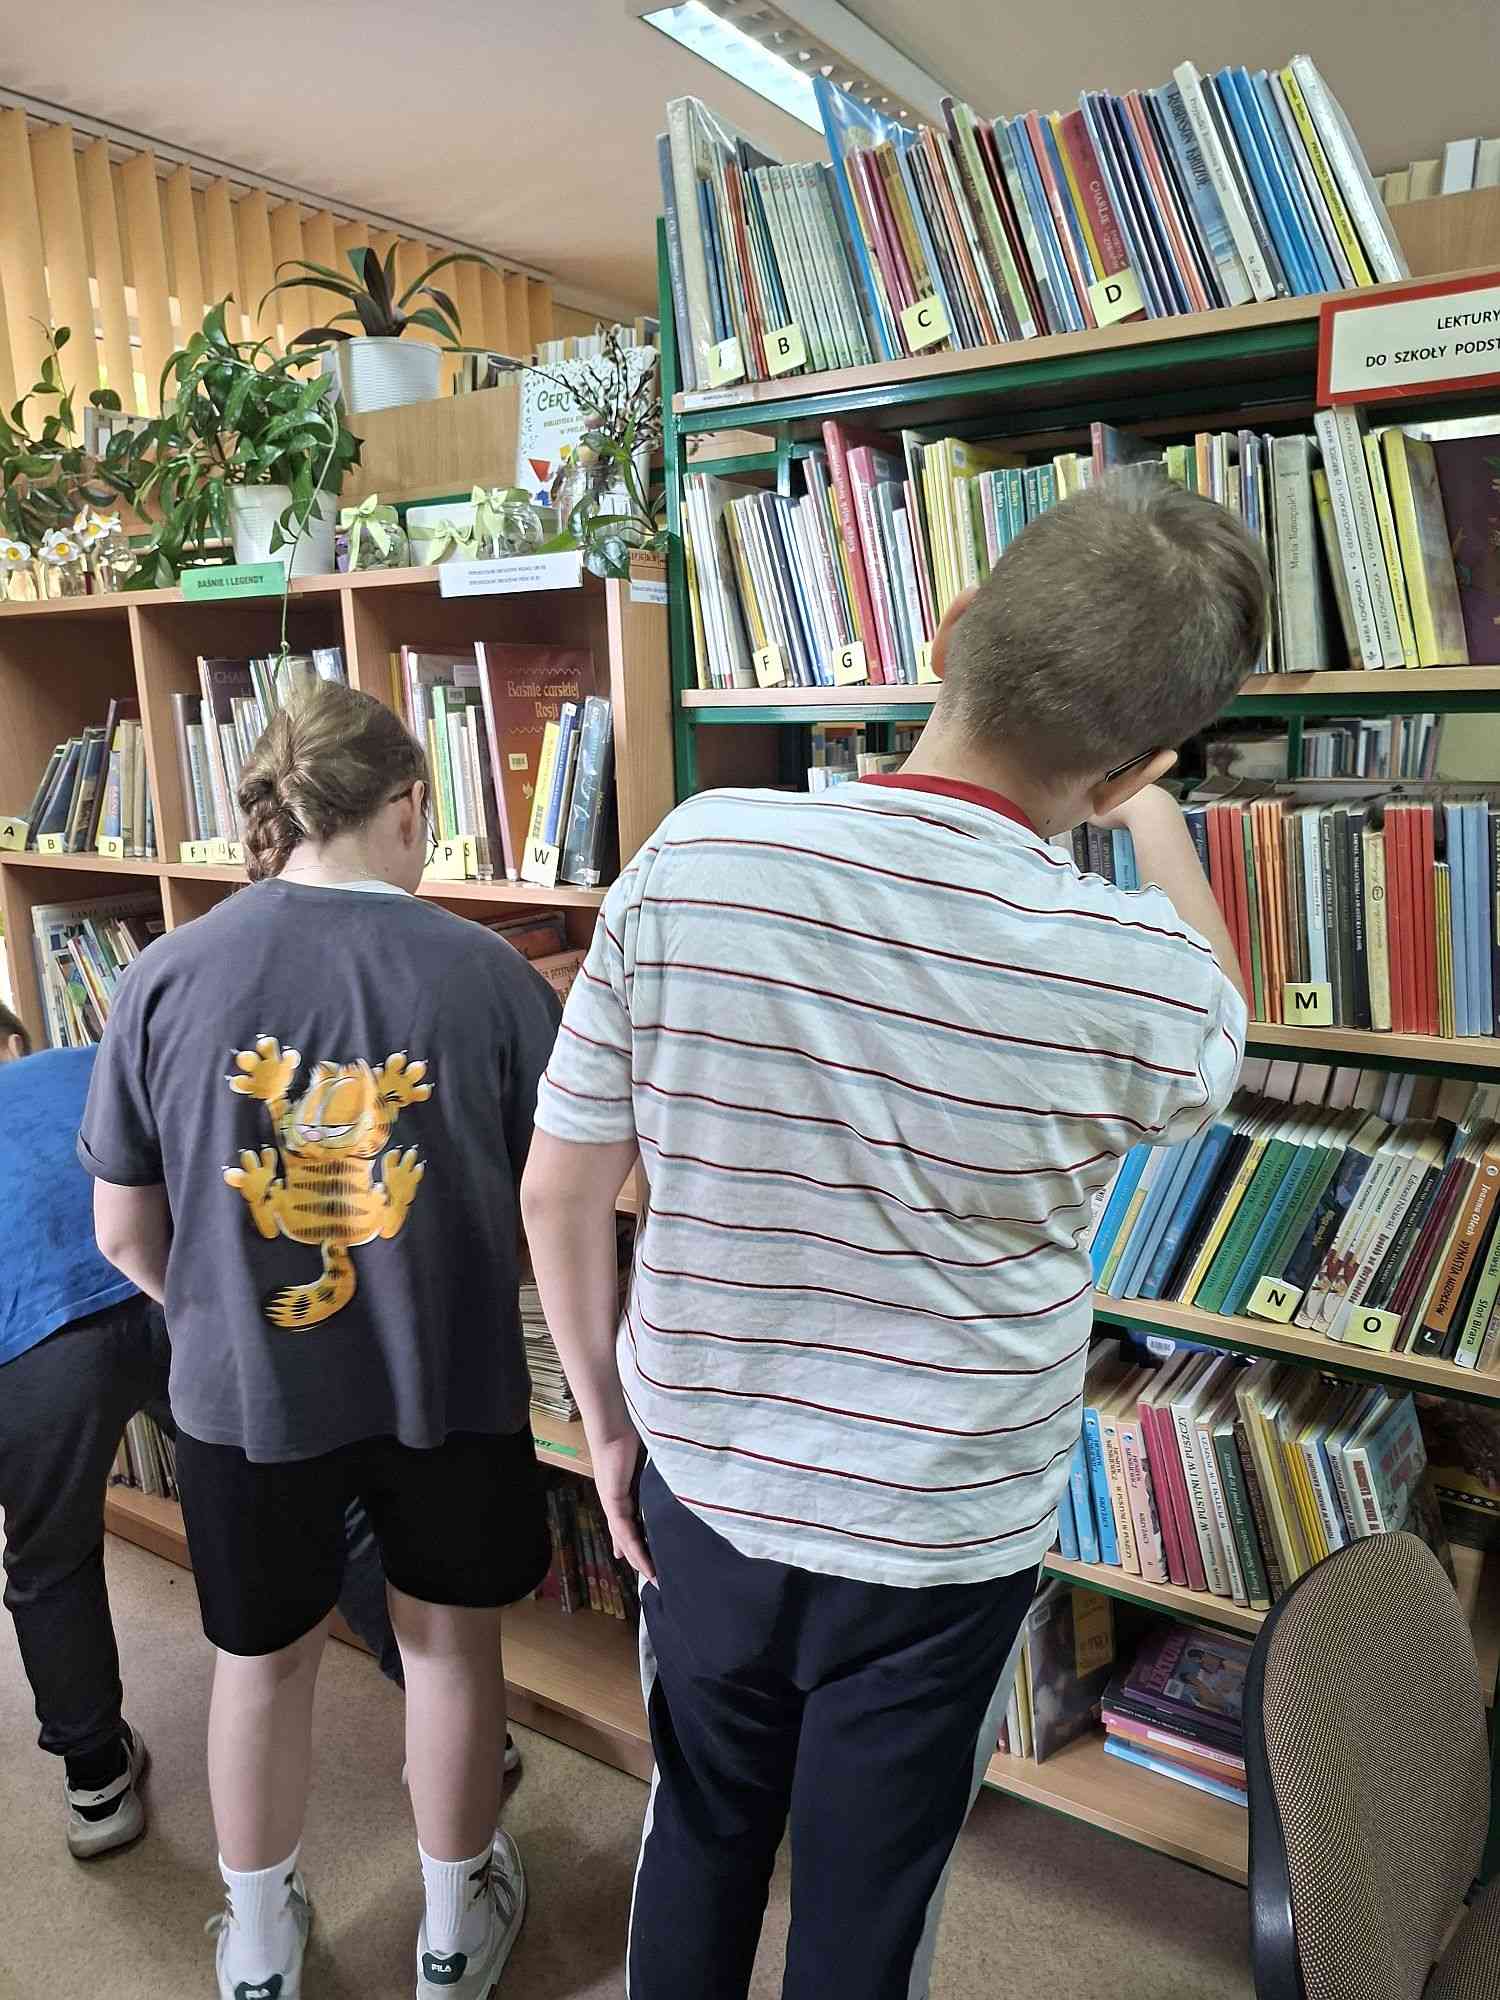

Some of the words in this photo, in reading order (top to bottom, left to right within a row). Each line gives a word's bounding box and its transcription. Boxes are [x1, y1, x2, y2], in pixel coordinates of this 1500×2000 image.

[1105, 284, 1122, 304] D
[918, 311, 932, 327] C
[1438, 310, 1500, 330] LEKTURY
[778, 337, 790, 354] B
[1366, 354, 1386, 367] DO
[1395, 346, 1447, 364] SZKOŁY
[763, 655, 771, 670] F
[842, 651, 852, 667] G
[507, 680, 542, 697] Baśnie
[3, 826, 14, 837] A
[48, 840, 55, 849] B
[109, 842, 116, 852] D
[445, 848, 452, 861] P
[535, 848, 550, 864] W
[1295, 991, 1318, 1009] M
[1473, 1182, 1490, 1213] Joanna
[1465, 1212, 1480, 1237] Olech
[1266, 1289, 1287, 1307] N
[1362, 1316, 1381, 1333] O
[1176, 1413, 1194, 1460] PUSZCZY
[1186, 1459, 1196, 1471] W
[1190, 1477, 1207, 1520] PUSTYNI
[1199, 1519, 1209, 1531] W
